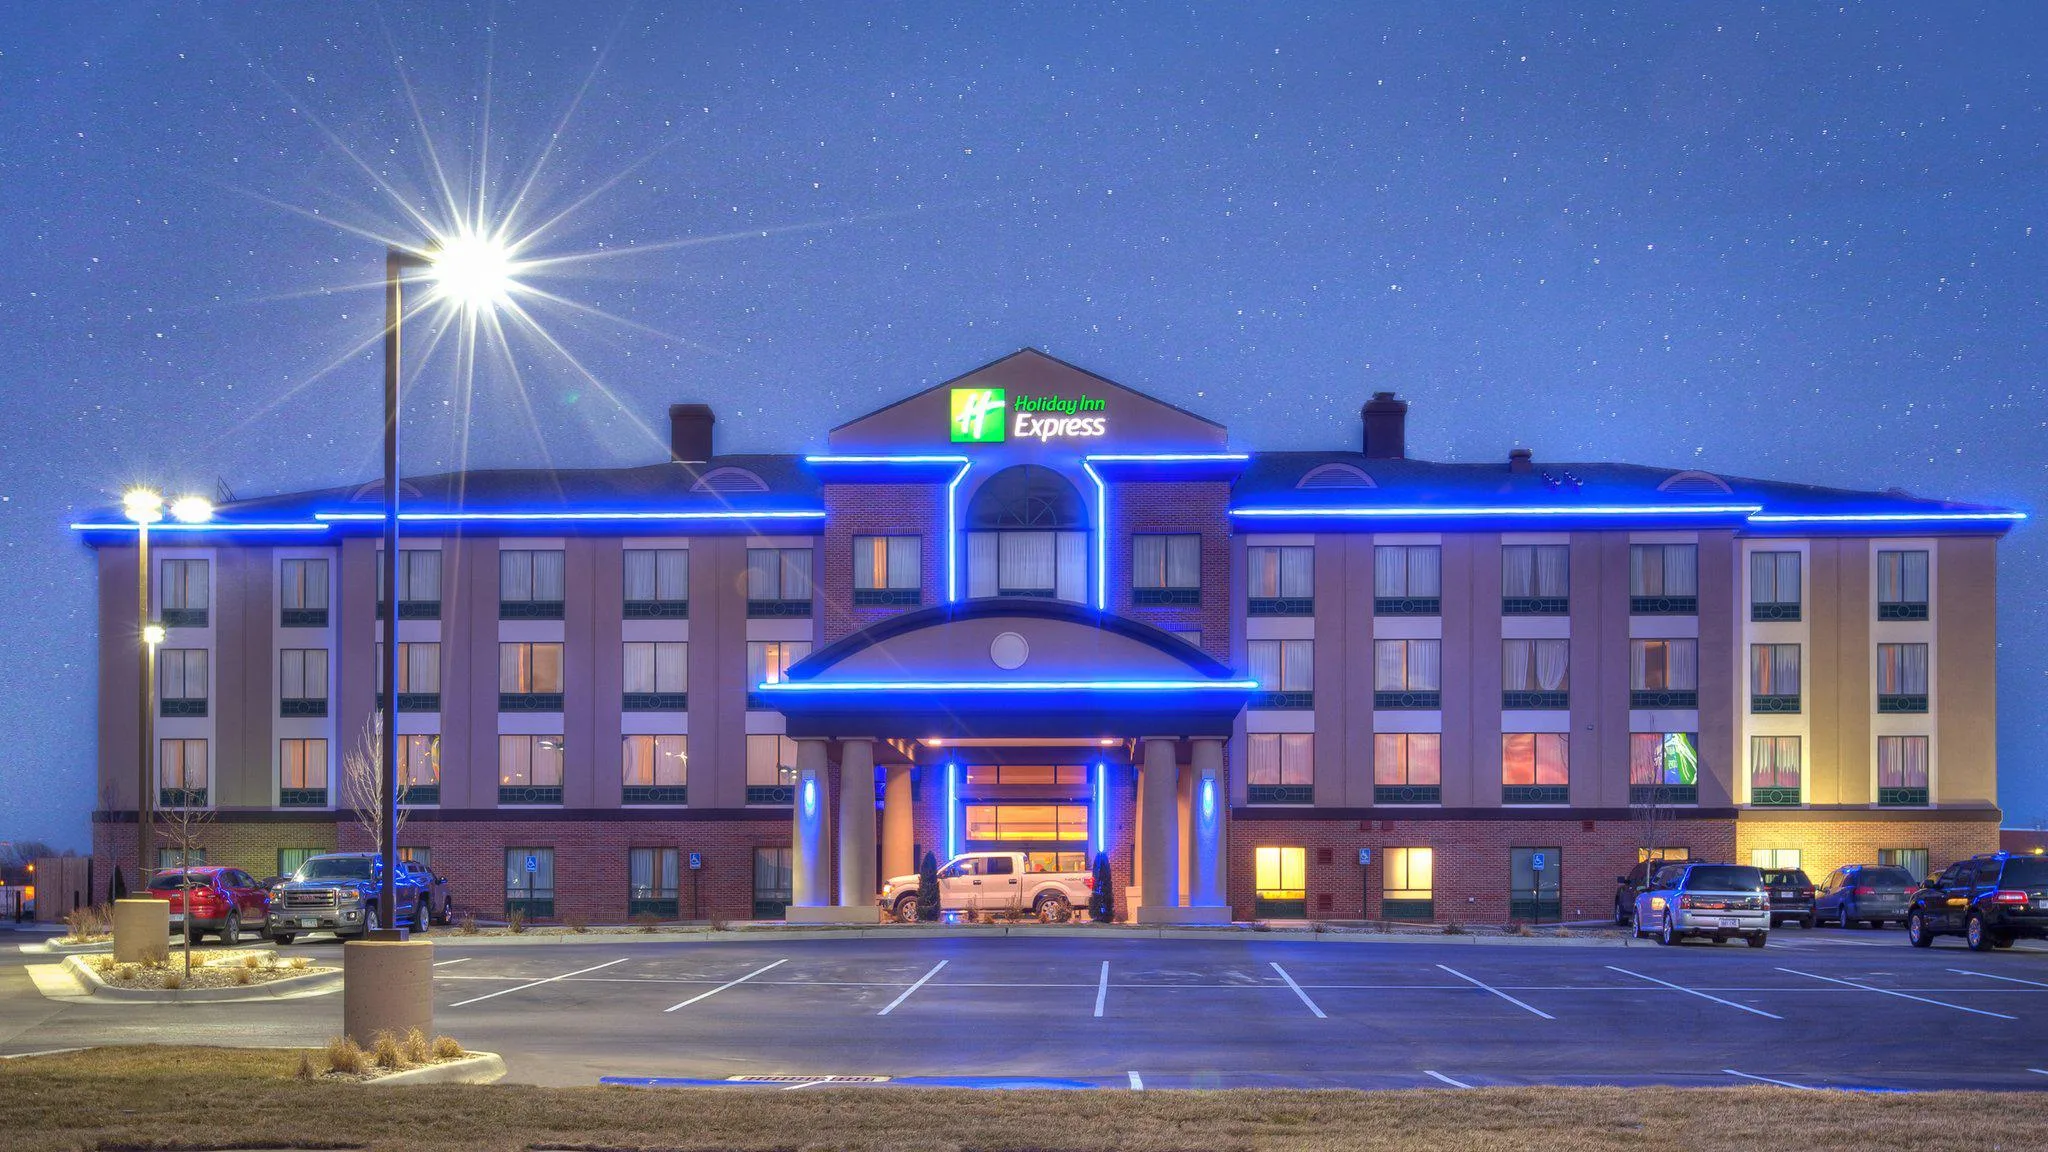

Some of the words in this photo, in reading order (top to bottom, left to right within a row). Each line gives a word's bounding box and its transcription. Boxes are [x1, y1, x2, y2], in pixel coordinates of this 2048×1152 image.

[1014, 395, 1077, 414] Holiday
[1079, 395, 1105, 411] Inn
[1014, 413, 1106, 442] Express
